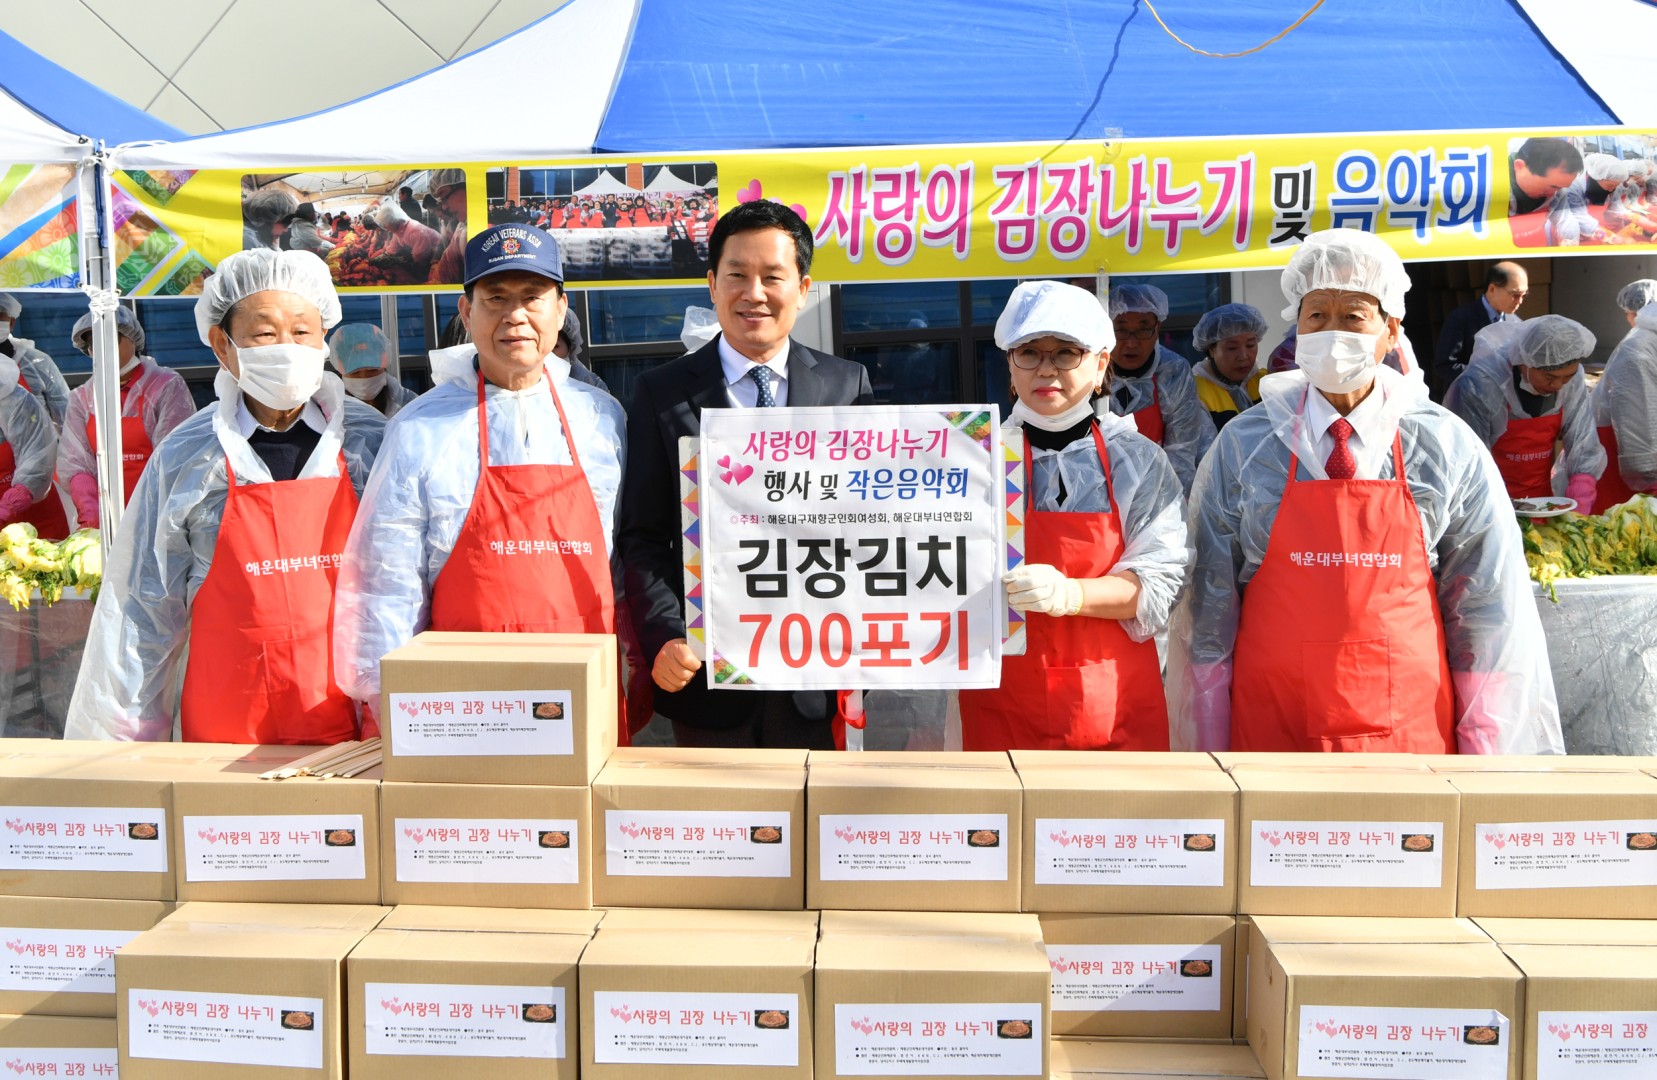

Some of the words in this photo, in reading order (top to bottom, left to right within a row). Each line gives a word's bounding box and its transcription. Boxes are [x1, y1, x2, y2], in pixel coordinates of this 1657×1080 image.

[814, 164, 972, 260] 사랑의
[990, 157, 1253, 256] 김장나누기
[1270, 166, 1313, 244] 및
[1329, 151, 1488, 239] 음악회
[481, 233, 500, 252] KOREAN
[499, 228, 528, 239] VETERANS
[742, 429, 817, 462] 사랑의
[825, 427, 950, 462] 김장나누기
[764, 470, 812, 502] 행사
[820, 473, 839, 501] 및
[846, 468, 969, 500] 작은음악회
[892, 511, 973, 524] 해운대부녀연합회
[489, 539, 593, 555] 해운대부녀연합회
[245, 553, 343, 577] 해운대부녀연합
[737, 535, 967, 598] 김장김치
[1289, 551, 1402, 568] 해운대부녀연합회
[739, 610, 969, 671] 700포기
[421, 701, 454, 715] 사랑의
[462, 701, 485, 715] 김장
[491, 700, 527, 714] 나누기
[24, 822, 57, 837] 사랑의
[65, 823, 87, 837] 김장
[93, 823, 126, 837] 나누기
[217, 831, 251, 845] 사랑의
[260, 831, 281, 845] 김장
[288, 830, 322, 844] 나누기
[426, 827, 461, 843] 사랑의
[468, 828, 491, 842] 김장
[497, 828, 532, 842] 나누기
[640, 826, 675, 841] 사랑의
[683, 826, 705, 841] 김장
[713, 827, 748, 841] 나누기
[855, 830, 891, 845] 사랑의
[898, 830, 922, 844] 김장
[929, 830, 965, 845] 나누기
[1070, 833, 1106, 849] 사랑의
[1114, 834, 1137, 849] 김장
[1146, 834, 1181, 849] 나누기
[1283, 831, 1319, 846] 사랑의
[1327, 831, 1351, 845] 김장
[1359, 830, 1395, 845] 나누기
[1508, 833, 1544, 847] 사랑의
[1552, 832, 1576, 846] 김장
[1584, 831, 1619, 845] 나누기
[25, 943, 58, 957] 사랑의
[65, 945, 87, 958] 김장
[94, 945, 122, 958] 나누
[1068, 961, 1103, 975] 사랑의
[1112, 961, 1135, 974] 김장
[1142, 961, 1177, 974] 나누기
[161, 1001, 197, 1017] 사랑의
[205, 1003, 230, 1019] 김장
[238, 1006, 274, 1021] 나누기
[403, 1002, 440, 1018] 사랑의
[449, 1003, 473, 1018] 김장
[482, 1004, 519, 1019] 나누기
[632, 1010, 671, 1025] 사랑의
[679, 1010, 705, 1026] 김장
[713, 1010, 751, 1025] 나누기
[874, 1022, 912, 1037] 사랑의
[921, 1021, 946, 1037] 김장
[955, 1021, 993, 1036] 나누기
[1338, 1024, 1377, 1040] 사랑의
[1387, 1025, 1413, 1041] 김장
[1421, 1026, 1460, 1041] 나누기
[1573, 1023, 1613, 1039] 사랑의
[1622, 1023, 1649, 1039] 김장
[25, 1062, 57, 1076] 사랑의
[64, 1063, 86, 1076] 김장
[93, 1063, 118, 1076] 나누
